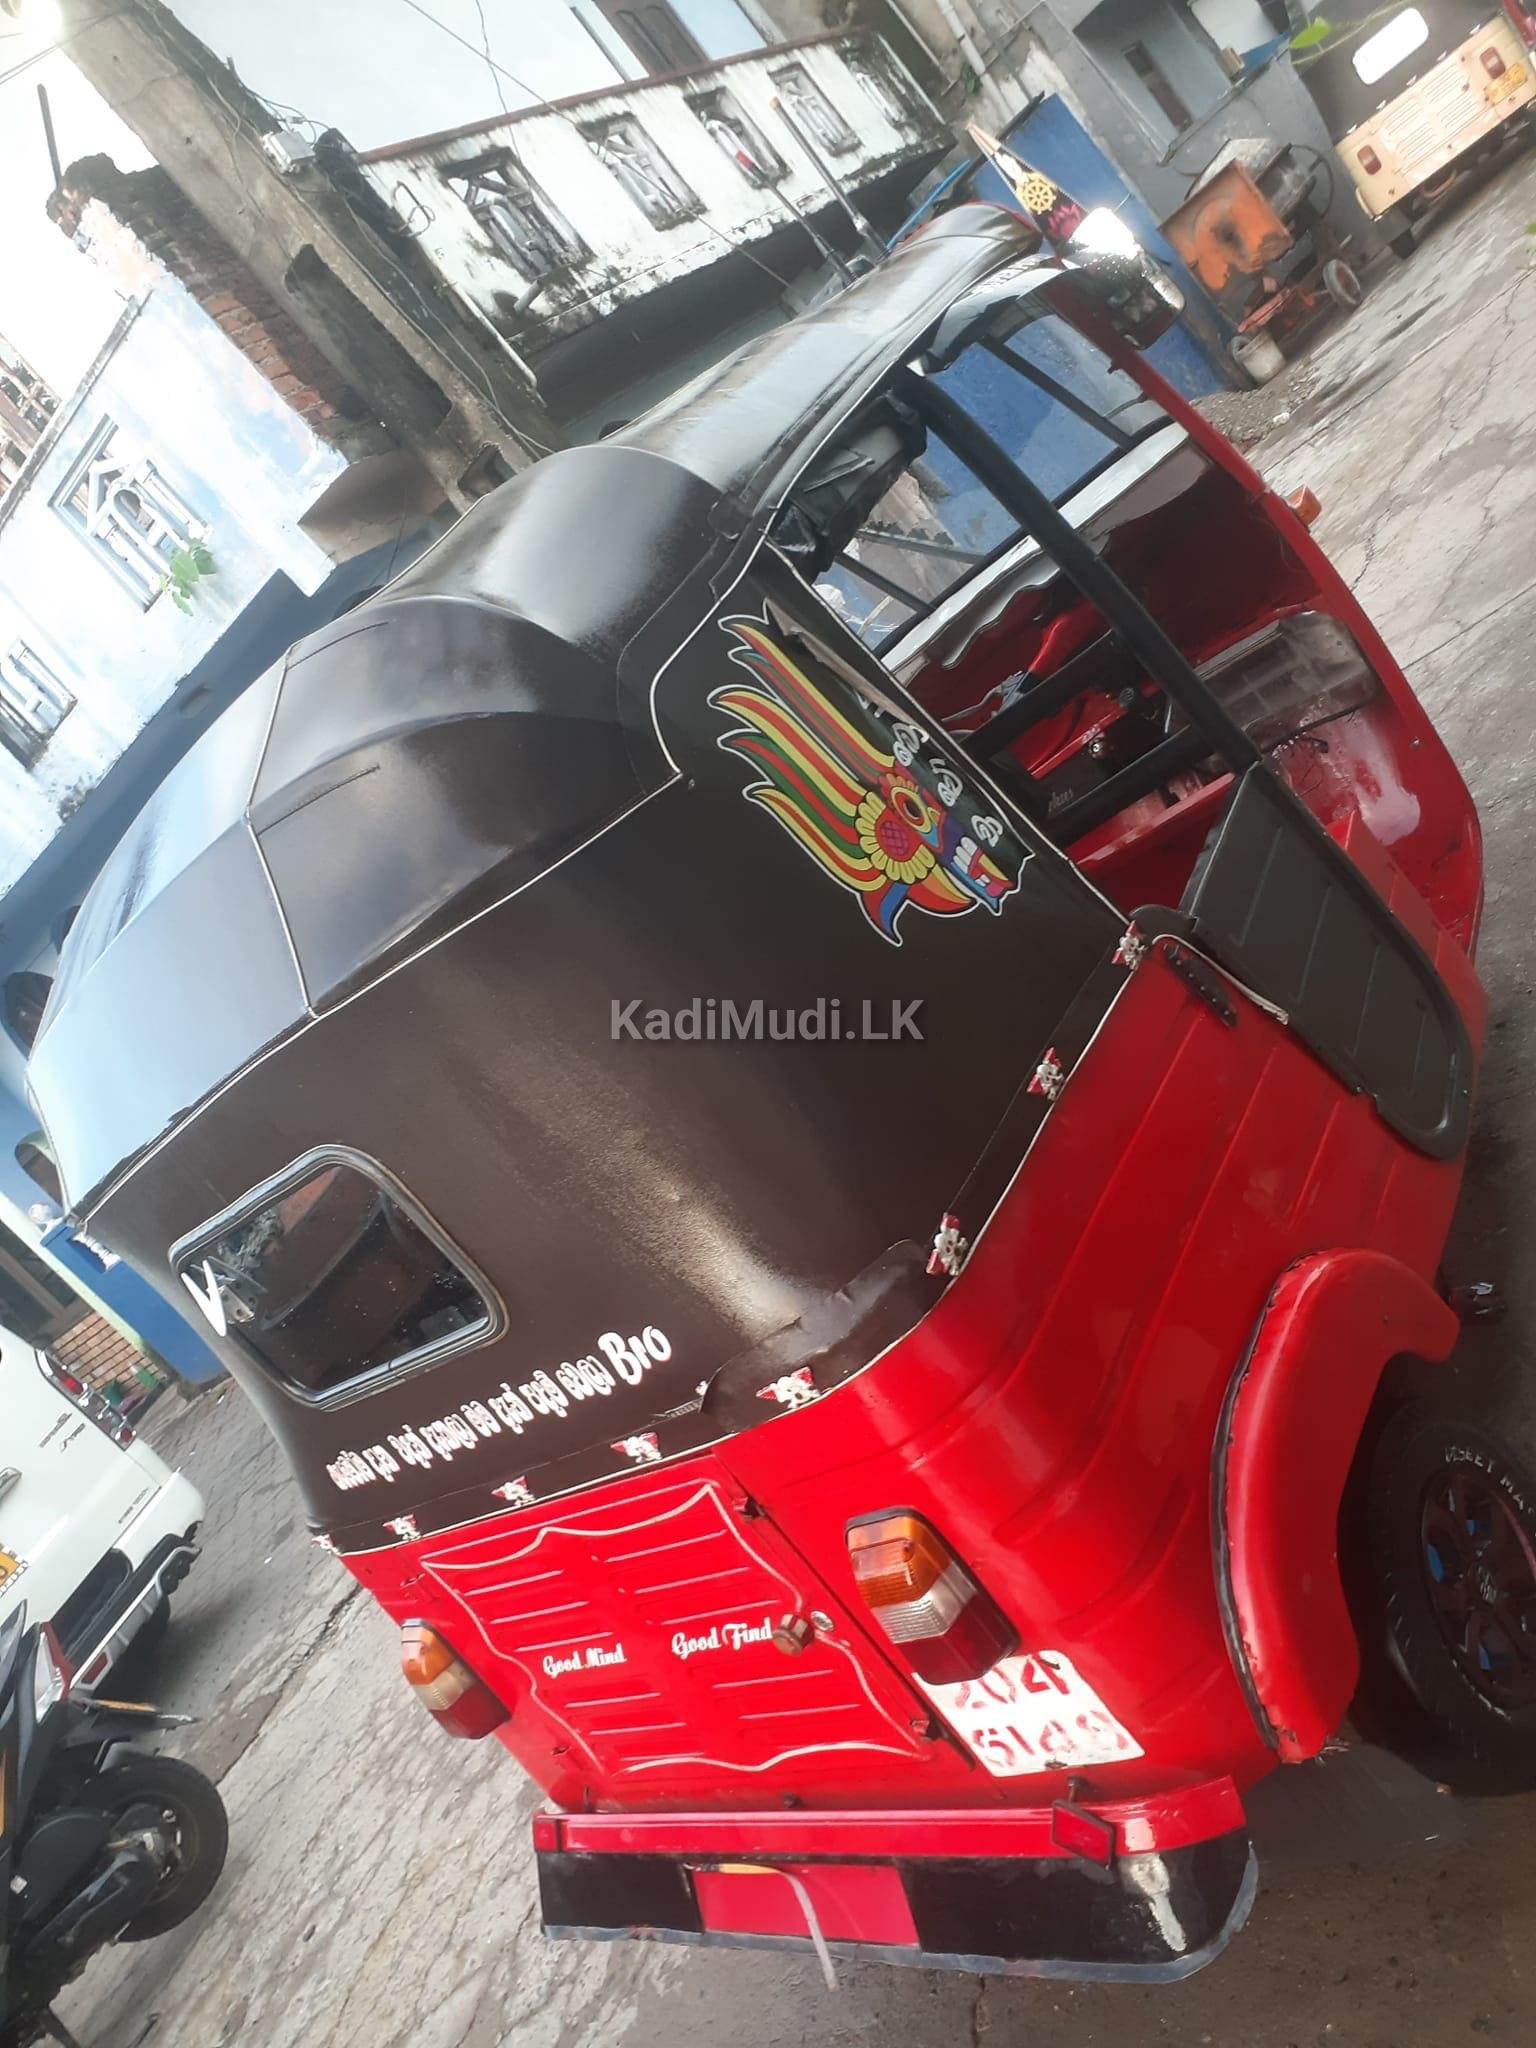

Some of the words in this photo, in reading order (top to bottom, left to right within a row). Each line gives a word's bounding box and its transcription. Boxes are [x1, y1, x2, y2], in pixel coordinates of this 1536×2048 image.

[461, 1405, 501, 1437] මම
[555, 1355, 615, 1396] වෙලා
[597, 1325, 673, 1386] Bro
[671, 1626, 720, 1660] Good
[720, 1616, 774, 1651] Find
[542, 1651, 584, 1679] Good
[584, 1643, 627, 1669] Mind
